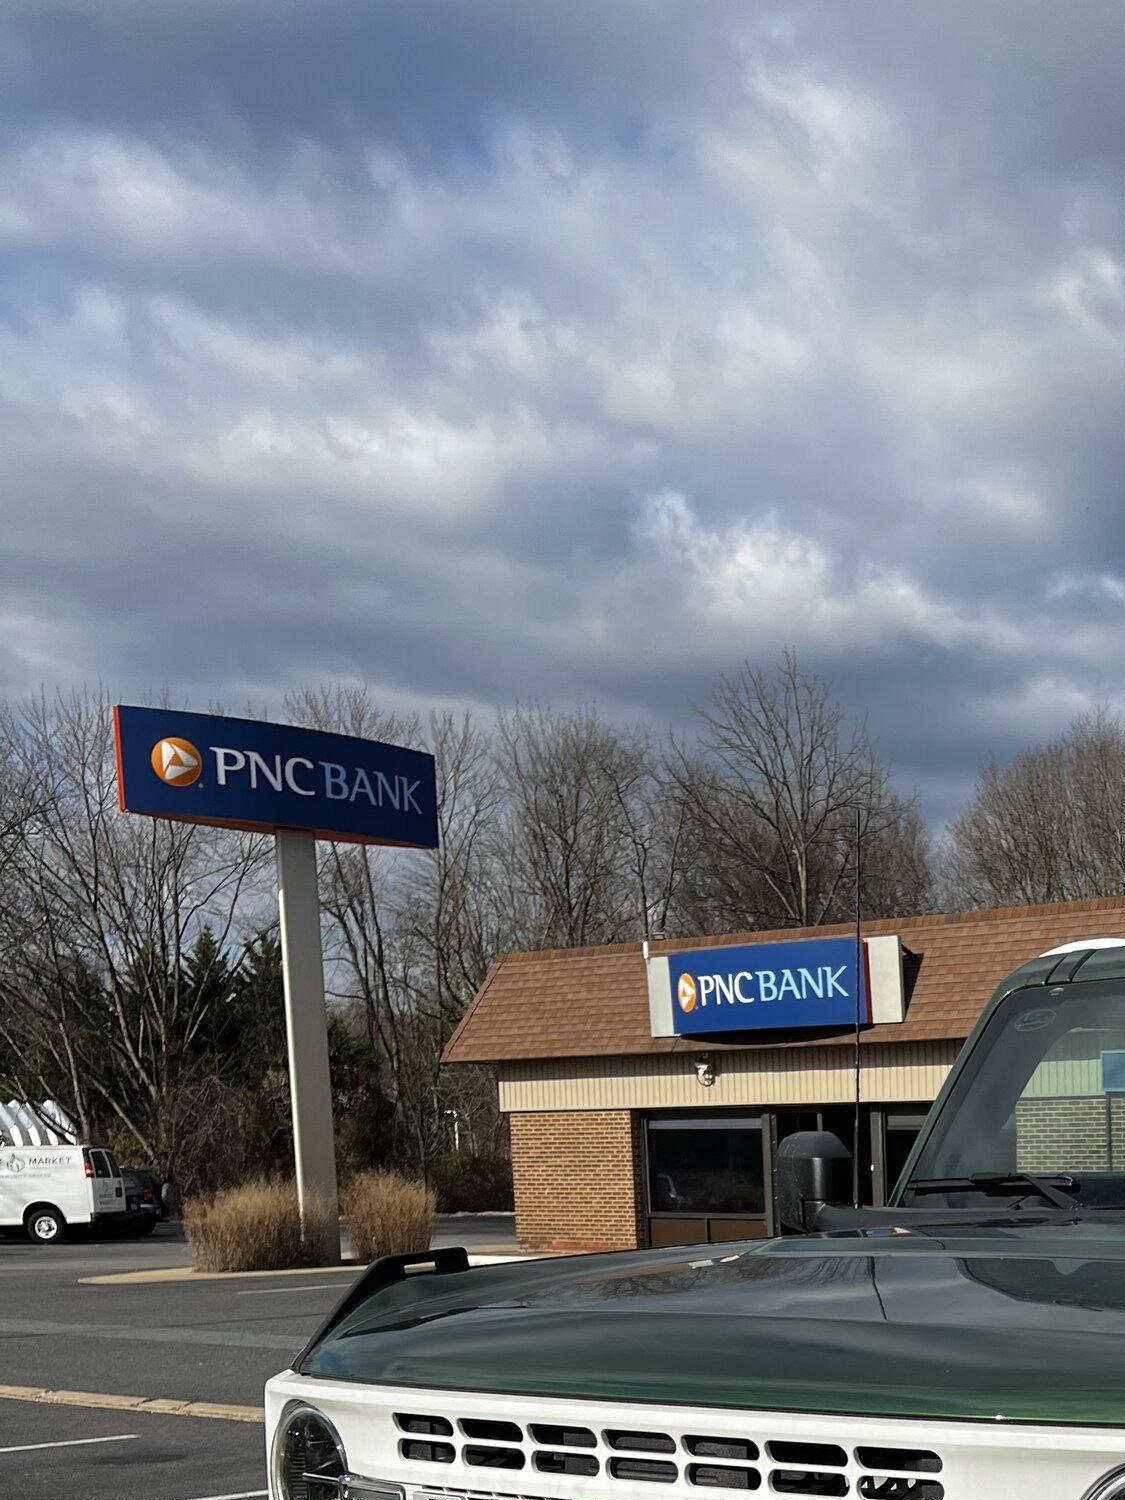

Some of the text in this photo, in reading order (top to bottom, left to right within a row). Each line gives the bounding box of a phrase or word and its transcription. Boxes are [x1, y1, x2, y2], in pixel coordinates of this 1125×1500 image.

[209, 746, 423, 815] PNC BANK
[697, 965, 849, 1007] PNC BANK
[28, 1156, 72, 1166] MARKET
